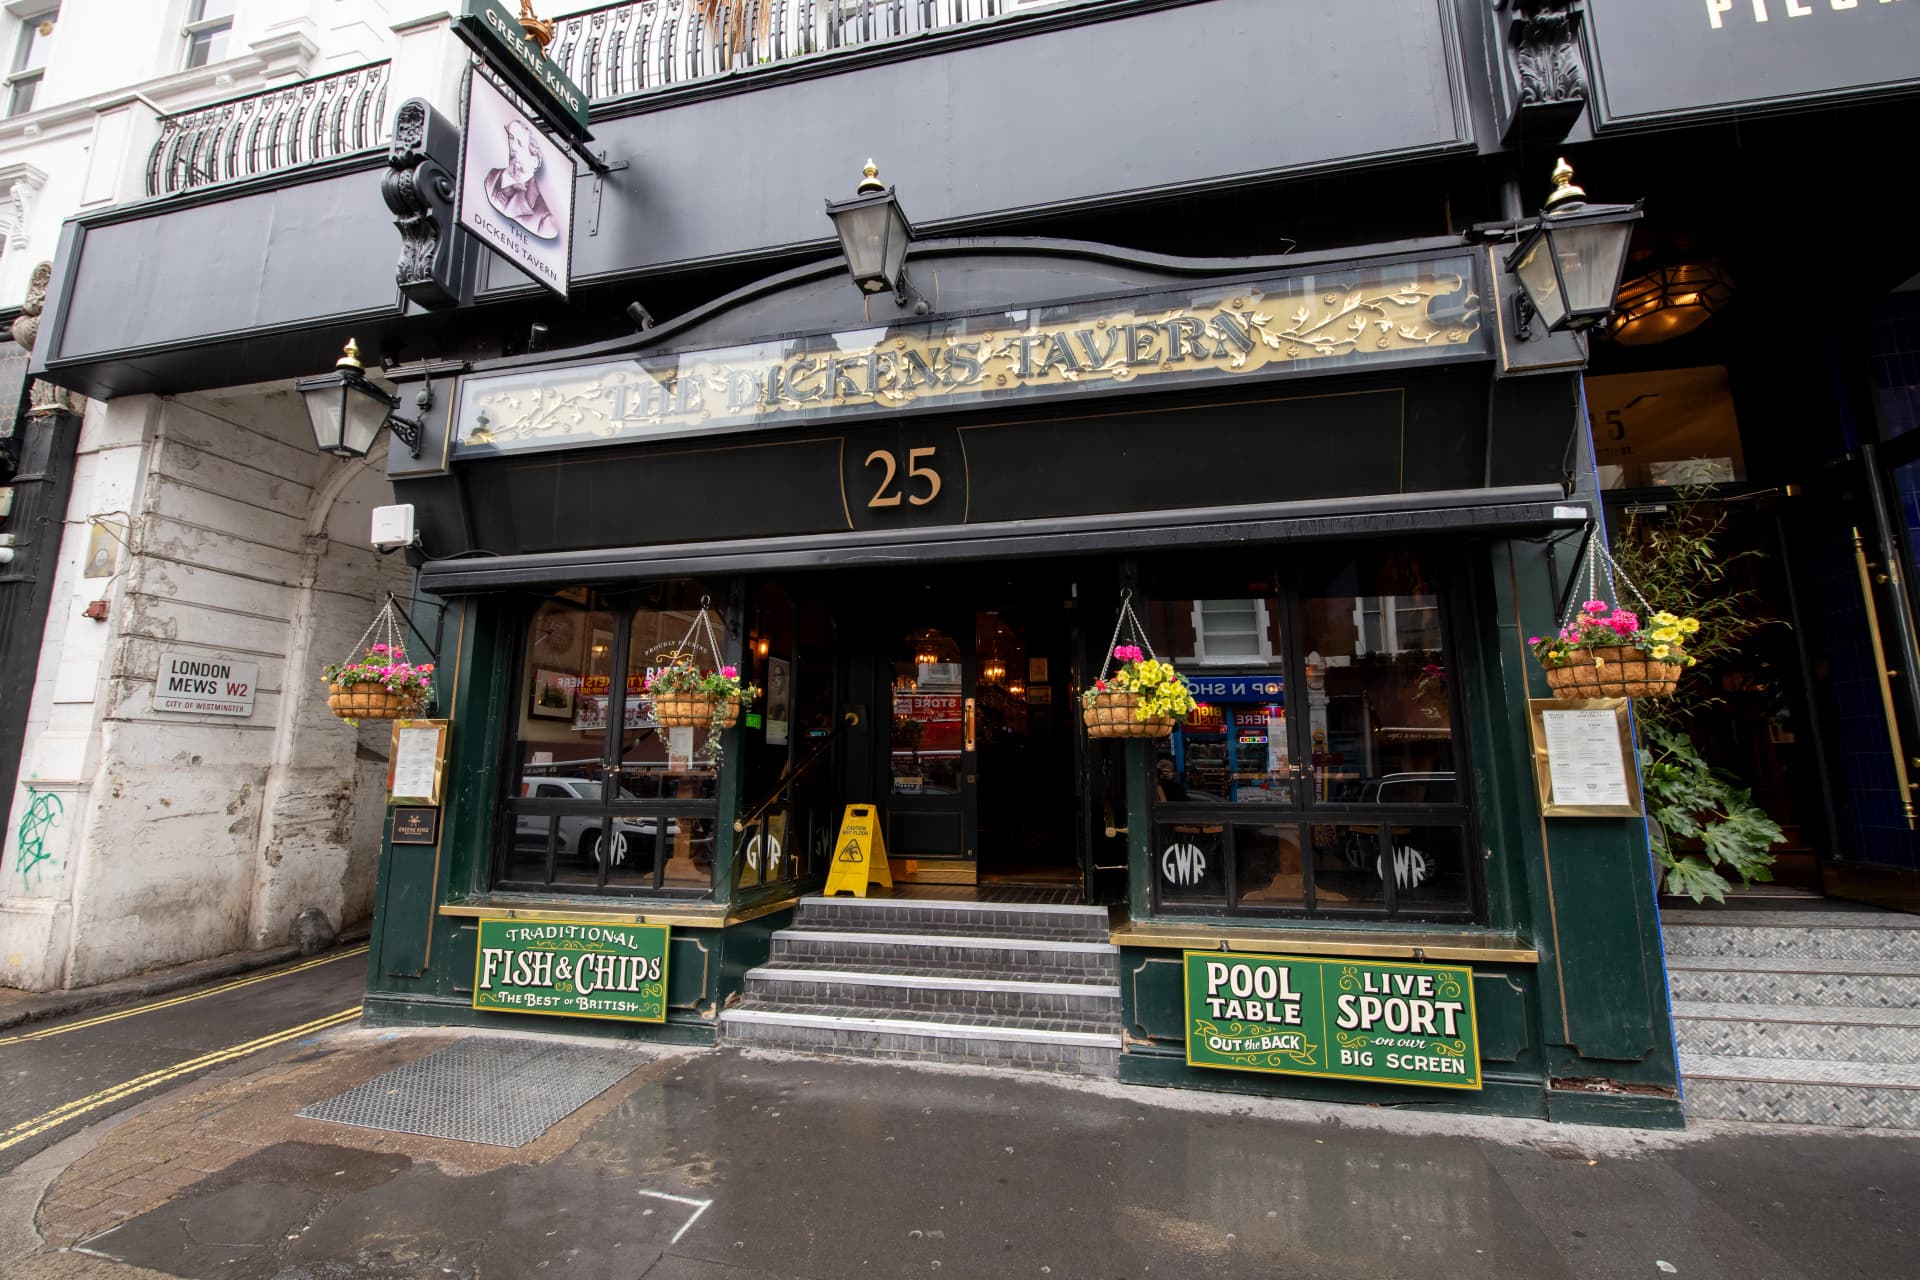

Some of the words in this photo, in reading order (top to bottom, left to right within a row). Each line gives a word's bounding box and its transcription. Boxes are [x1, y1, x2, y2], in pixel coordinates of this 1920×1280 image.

[485, 7, 544, 76] GREENE
[546, 73, 580, 113] KING
[473, 212, 520, 255] DICKENS
[520, 249, 558, 282] TAVERN
[509, 224, 529, 246] THE
[604, 373, 708, 422] THE
[727, 341, 983, 412] DICKENS
[1013, 309, 1258, 378] TAVERN
[864, 446, 943, 509] 25
[644, 640, 676, 656] PROUDLY
[171, 659, 231, 679] LONDON
[168, 677, 218, 695] MEWS
[226, 682, 248, 697] W2
[165, 700, 182, 708] CITY
[196, 703, 244, 712] WESTMINSTER
[1162, 842, 1206, 887] GWR
[506, 925, 639, 950] TRADITIONAL
[1206, 961, 1302, 1001] POOL
[1363, 972, 1436, 998] LIVE
[498, 991, 522, 1004] THE
[524, 993, 561, 1007] BEST
[575, 997, 639, 1012] BRITISH
[1206, 998, 1302, 1025] TABLE
[1335, 994, 1465, 1036] SPORT
[1209, 1036, 1242, 1051] OUT
[1244, 1038, 1261, 1051] the
[1261, 1036, 1300, 1050] BACK
[1371, 1036, 1395, 1048] on
[1396, 1038, 1427, 1050] our
[1340, 1050, 1374, 1067] BIG
[1386, 1054, 1466, 1074] SCREEN
